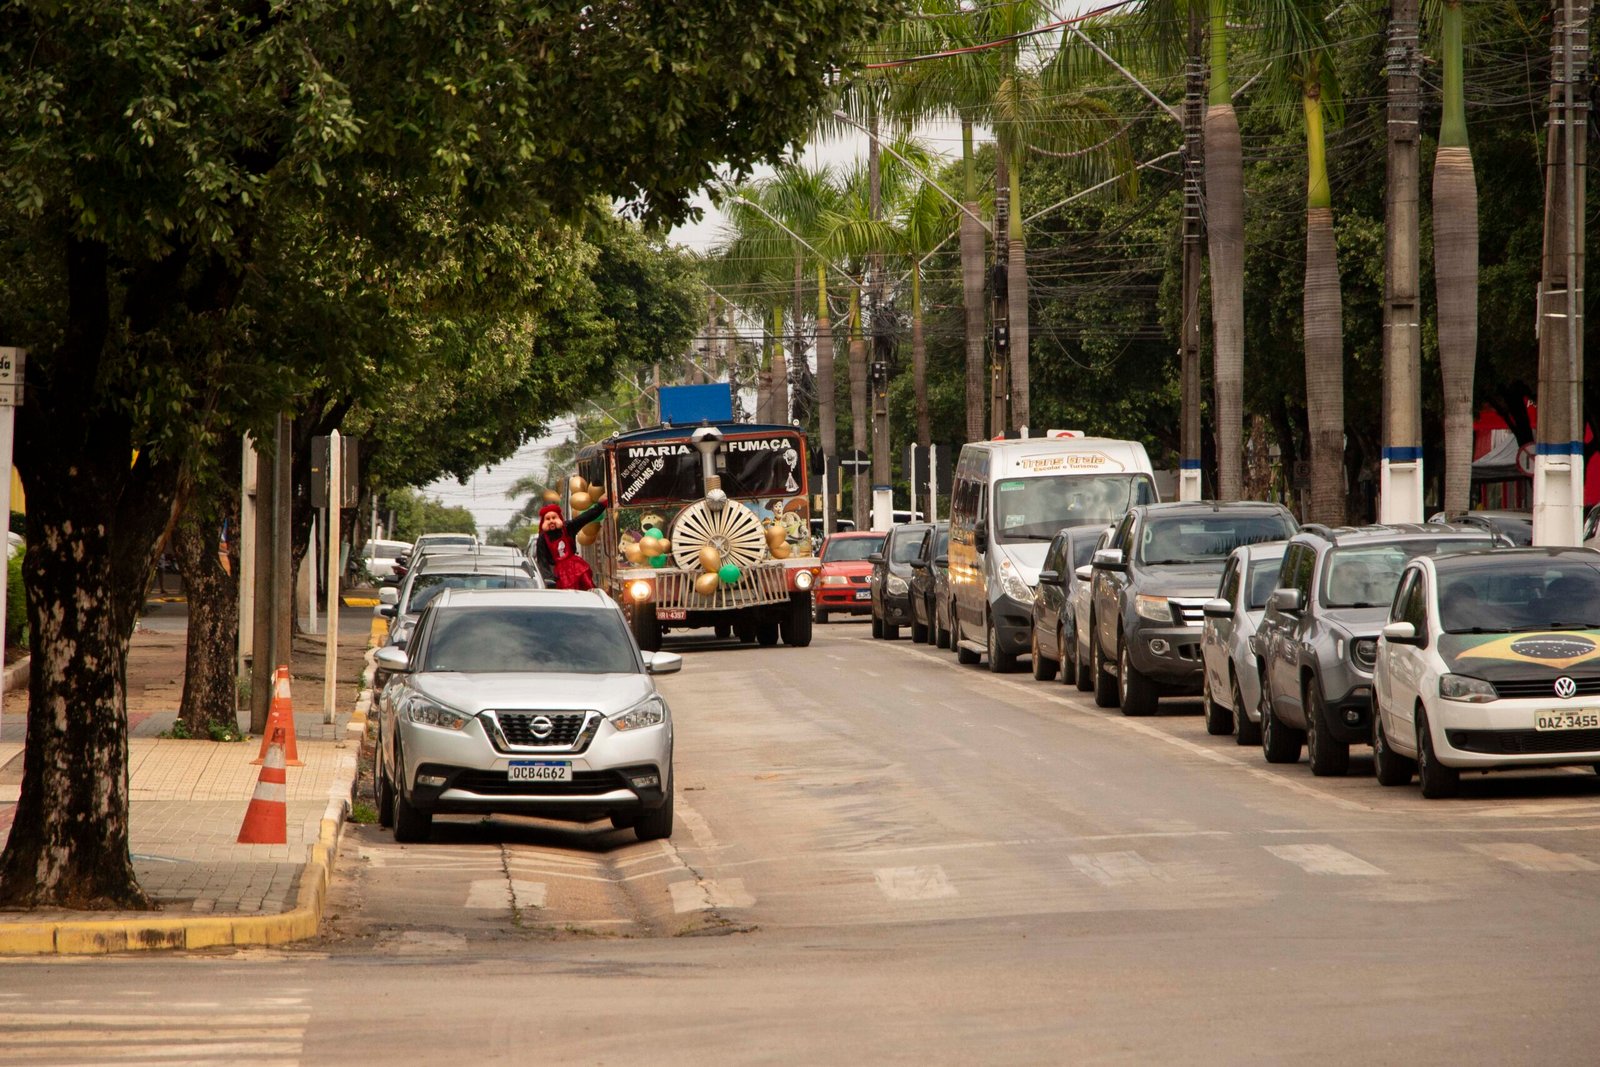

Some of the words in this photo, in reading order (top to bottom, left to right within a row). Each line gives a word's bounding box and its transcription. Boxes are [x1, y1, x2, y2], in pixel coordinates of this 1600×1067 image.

[629, 445, 690, 458] MARIA
[729, 438, 791, 452] FUMAÇA
[621, 467, 654, 502] TACURU-MS
[513, 767, 565, 779] QCB4G62
